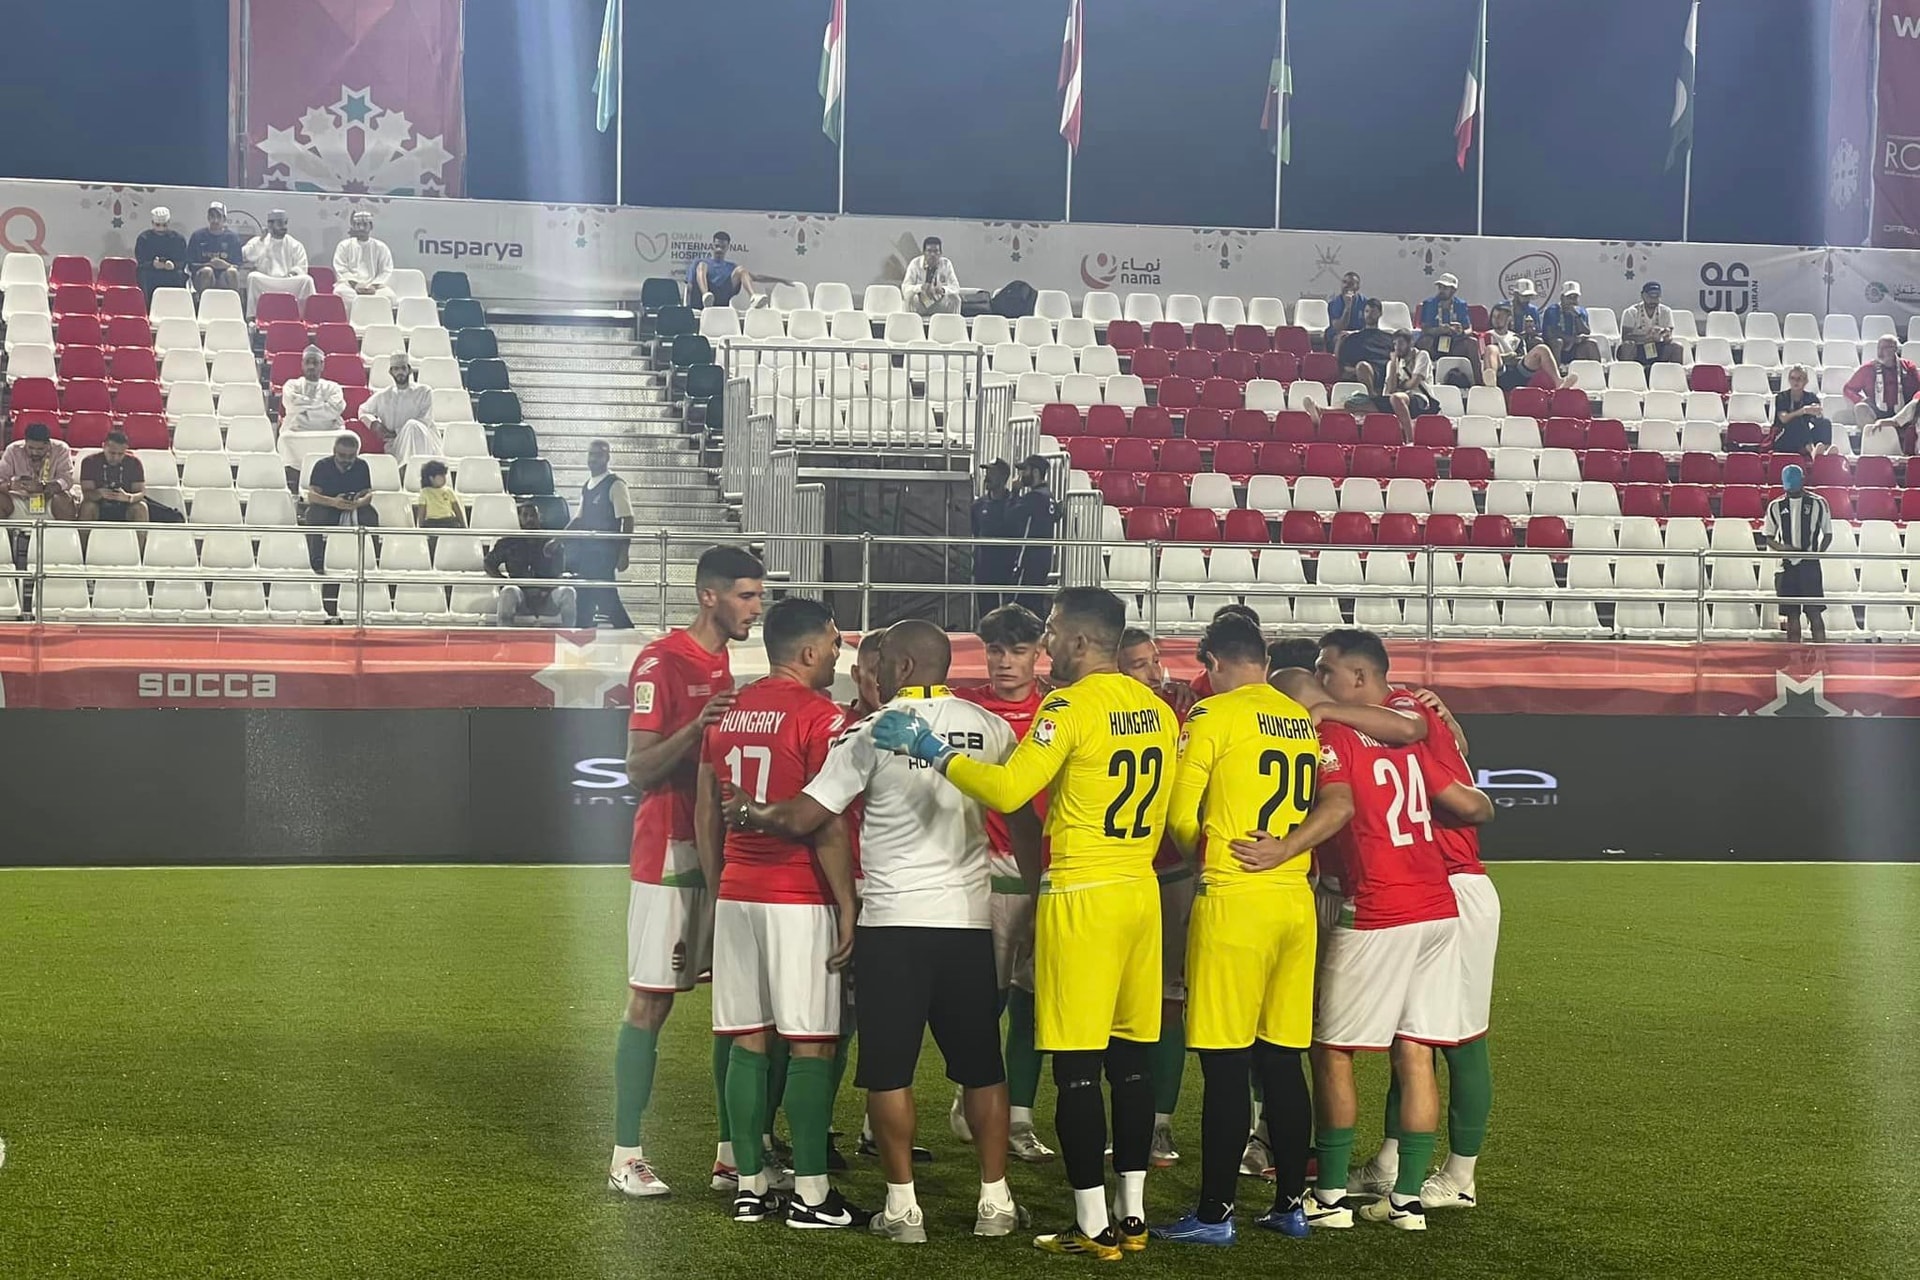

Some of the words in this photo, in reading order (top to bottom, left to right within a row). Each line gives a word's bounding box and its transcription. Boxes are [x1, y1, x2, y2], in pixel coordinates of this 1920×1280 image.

[671, 232, 702, 241] OMAN
[671, 241, 749, 252] INTERNANAL
[417, 238, 523, 261] insparya
[671, 251, 713, 260] HOSPITA
[1121, 257, 1160, 273] نماء
[1121, 273, 1161, 285] nama
[1508, 277, 1551, 296] SRT
[720, 710, 787, 734] HUNGARY
[1109, 709, 1161, 736] HUNGARY
[1257, 712, 1316, 739] HUNGARY
[724, 745, 772, 804] 17
[1104, 747, 1163, 839] 22
[1257, 749, 1317, 841] 29
[1373, 753, 1433, 847] 24
